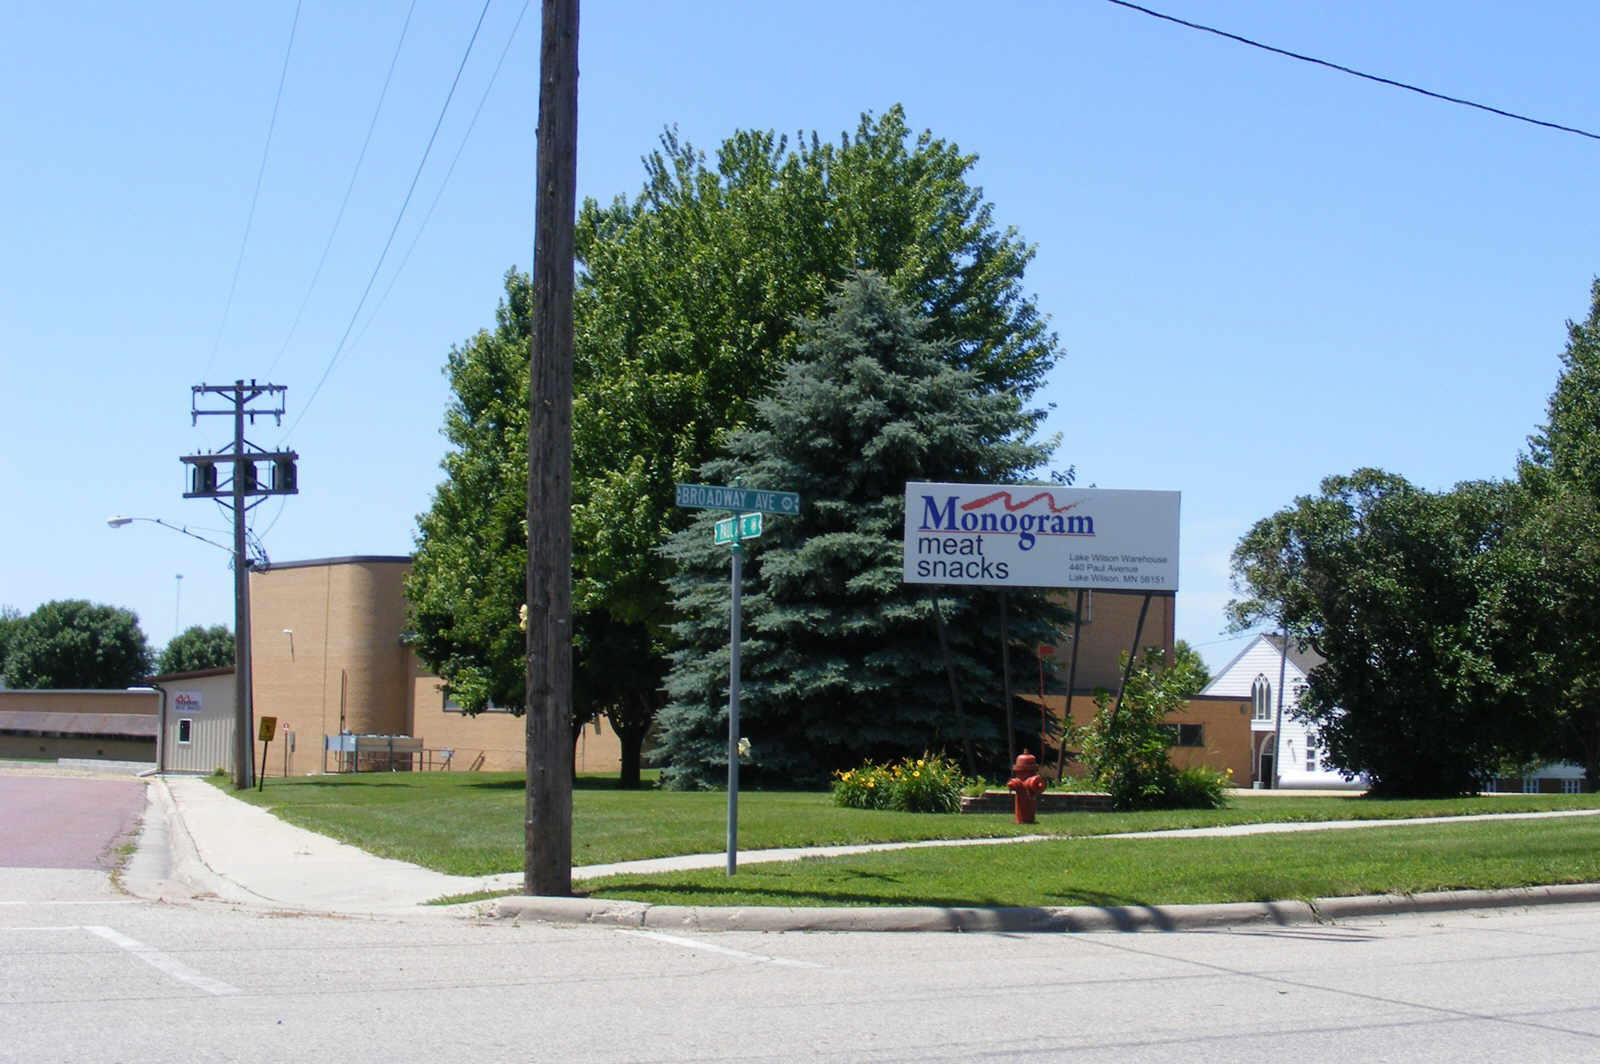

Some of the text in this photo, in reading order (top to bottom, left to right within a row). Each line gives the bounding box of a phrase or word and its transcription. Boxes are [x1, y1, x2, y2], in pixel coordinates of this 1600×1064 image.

[682, 487, 776, 510] BROADWAY AVE
[918, 495, 1096, 551] Monogram
[918, 534, 984, 556] meat
[917, 556, 1009, 580] snacks
[1069, 553, 1168, 564] Lake Wilson Warehouse
[1069, 563, 1139, 573] 440 Paul Avenue
[1069, 573, 1089, 582] Lake
[1123, 575, 1138, 583] MN
[1140, 575, 1165, 584] 56151
